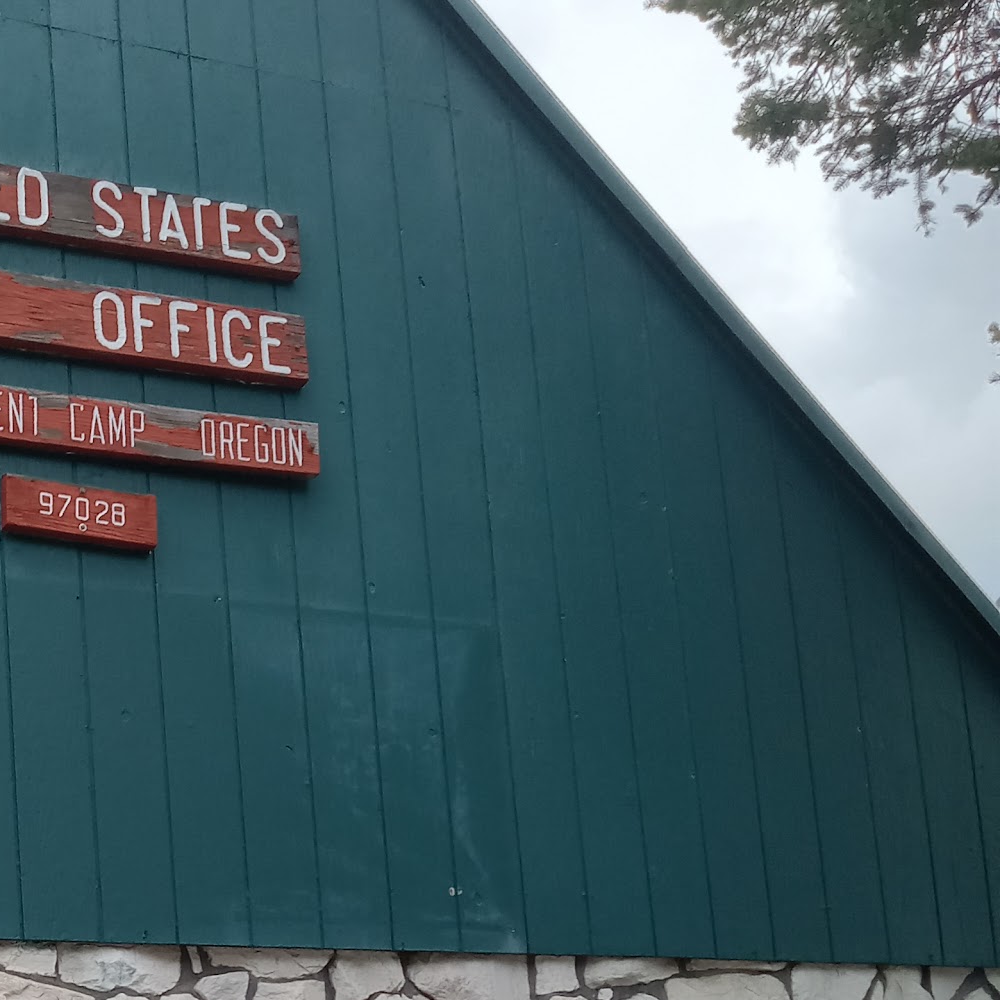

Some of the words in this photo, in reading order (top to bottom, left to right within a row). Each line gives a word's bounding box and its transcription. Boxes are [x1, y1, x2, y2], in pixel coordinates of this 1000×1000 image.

[92, 180, 287, 264] STATES
[93, 291, 292, 375] OFFICE
[69, 402, 146, 449] CAMP
[200, 417, 304, 468] OREGON
[39, 491, 126, 527] 97028
